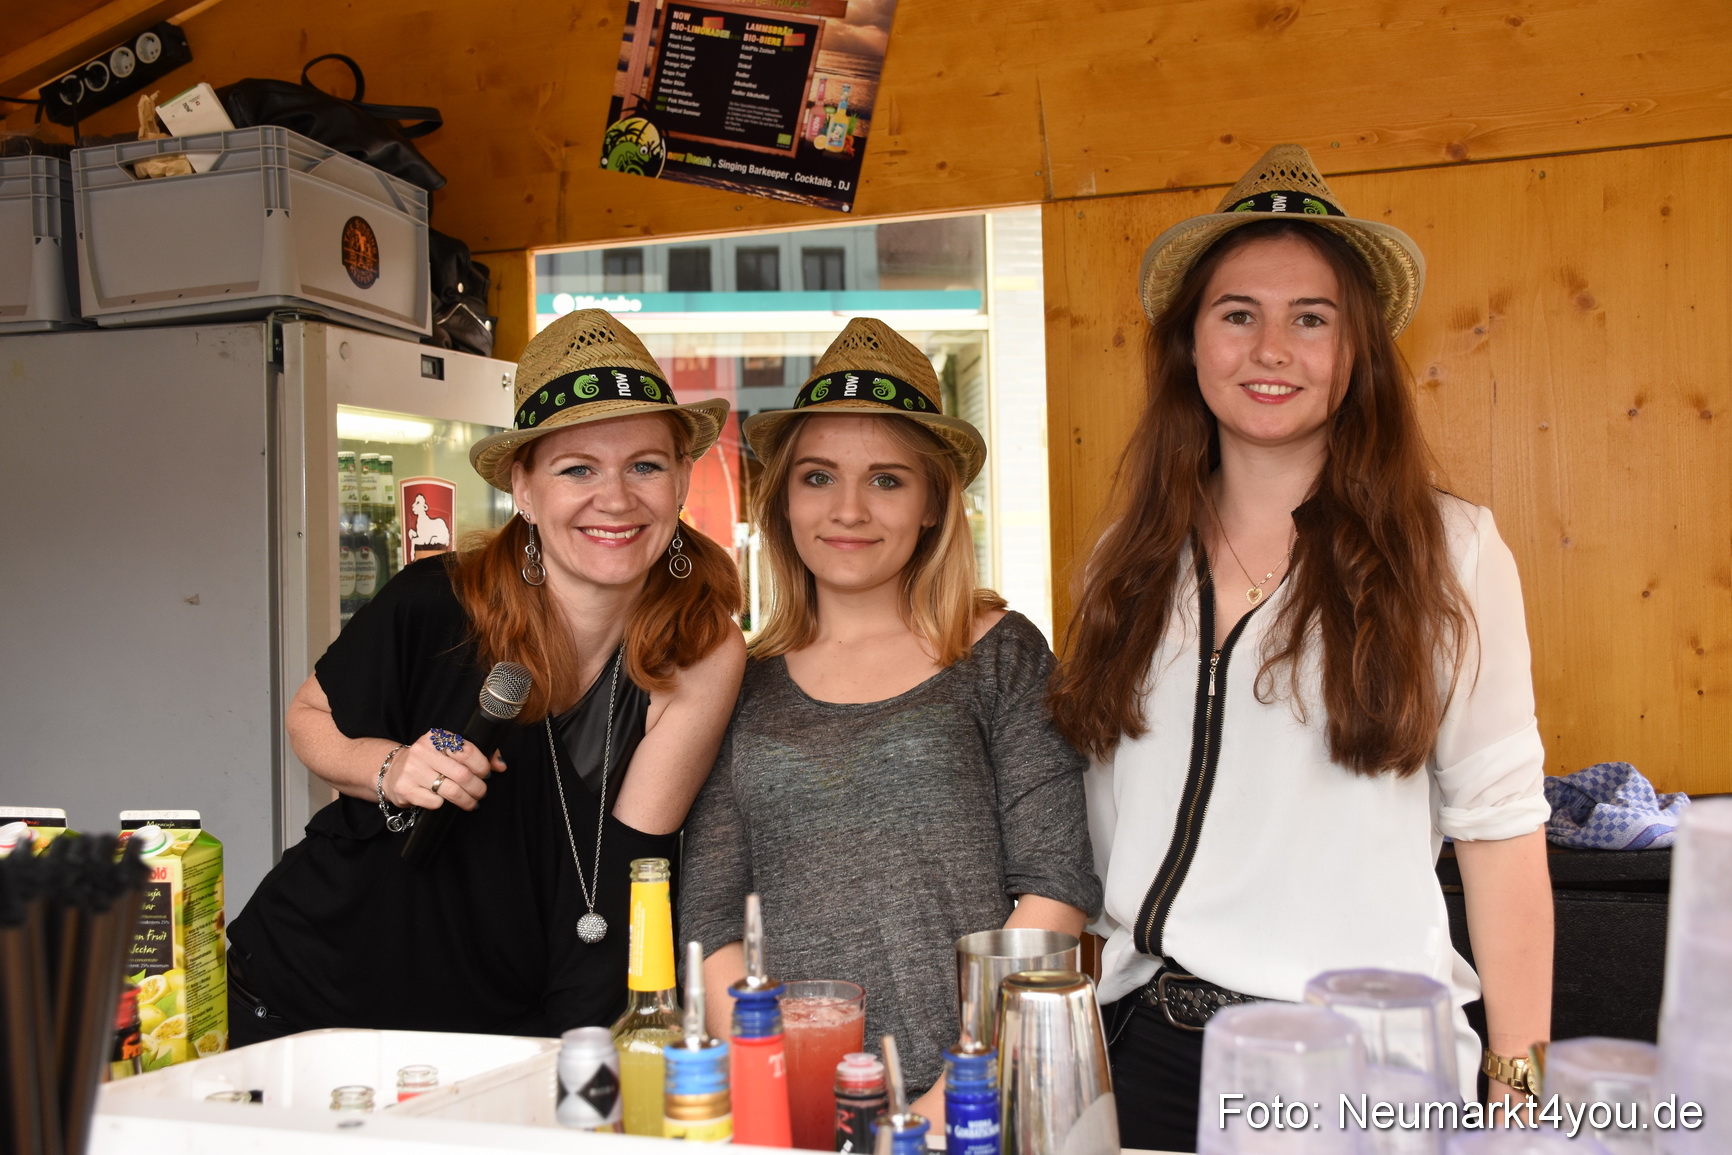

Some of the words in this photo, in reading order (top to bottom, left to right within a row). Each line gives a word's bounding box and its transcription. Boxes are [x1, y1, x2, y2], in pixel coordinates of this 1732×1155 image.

[673, 10, 691, 21] NOW
[743, 33, 782, 46] BIO-BIERE
[718, 159, 748, 175] Singing
[748, 164, 790, 181] Barkeeper
[794, 172, 833, 189] Cocktails
[838, 180, 851, 192] DJ
[615, 372, 632, 397] now
[843, 375, 860, 397] now
[146, 929, 168, 941] Fruit
